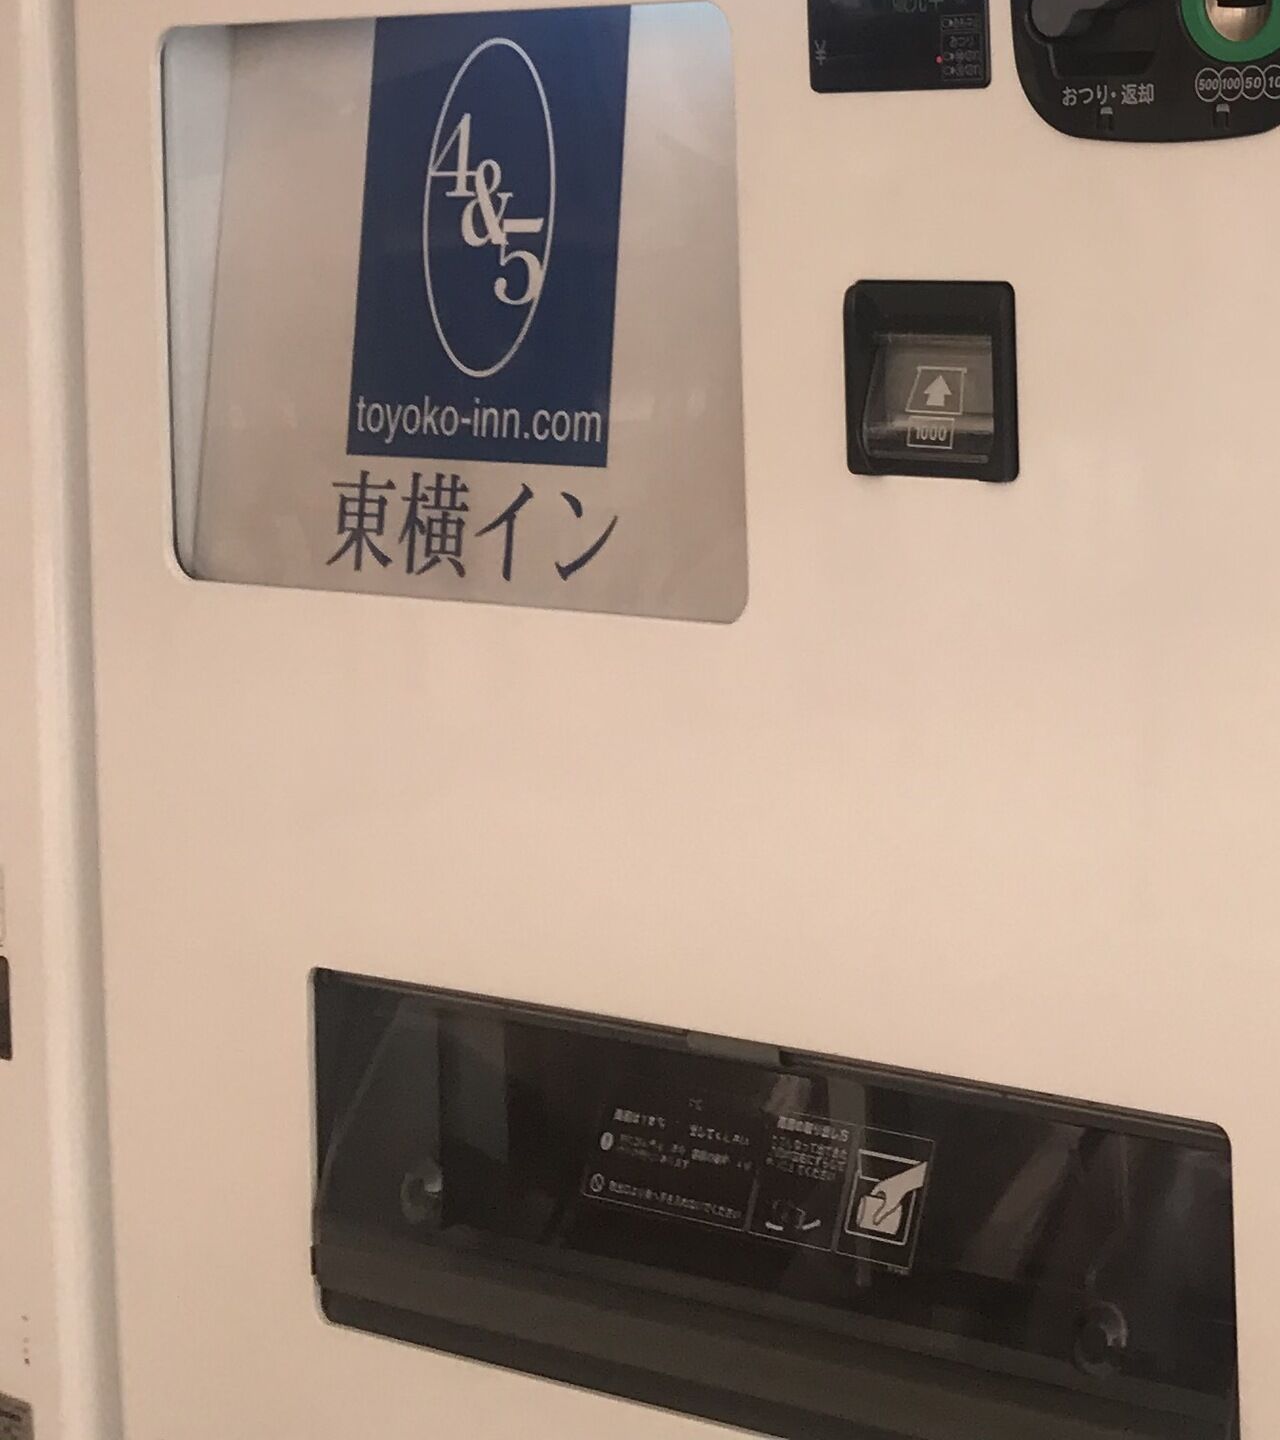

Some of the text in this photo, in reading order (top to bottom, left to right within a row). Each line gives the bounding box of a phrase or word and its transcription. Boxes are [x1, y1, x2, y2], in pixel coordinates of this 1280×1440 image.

[1062, 83, 1155, 106] おつり・返却
[1199, 77, 1219, 91] 500
[1222, 77, 1240, 90] 100
[1244, 76, 1263, 89] 50
[356, 394, 603, 445] toyoko-inn.com
[914, 423, 949, 443] 1000
[326, 470, 620, 582] 東横イン
